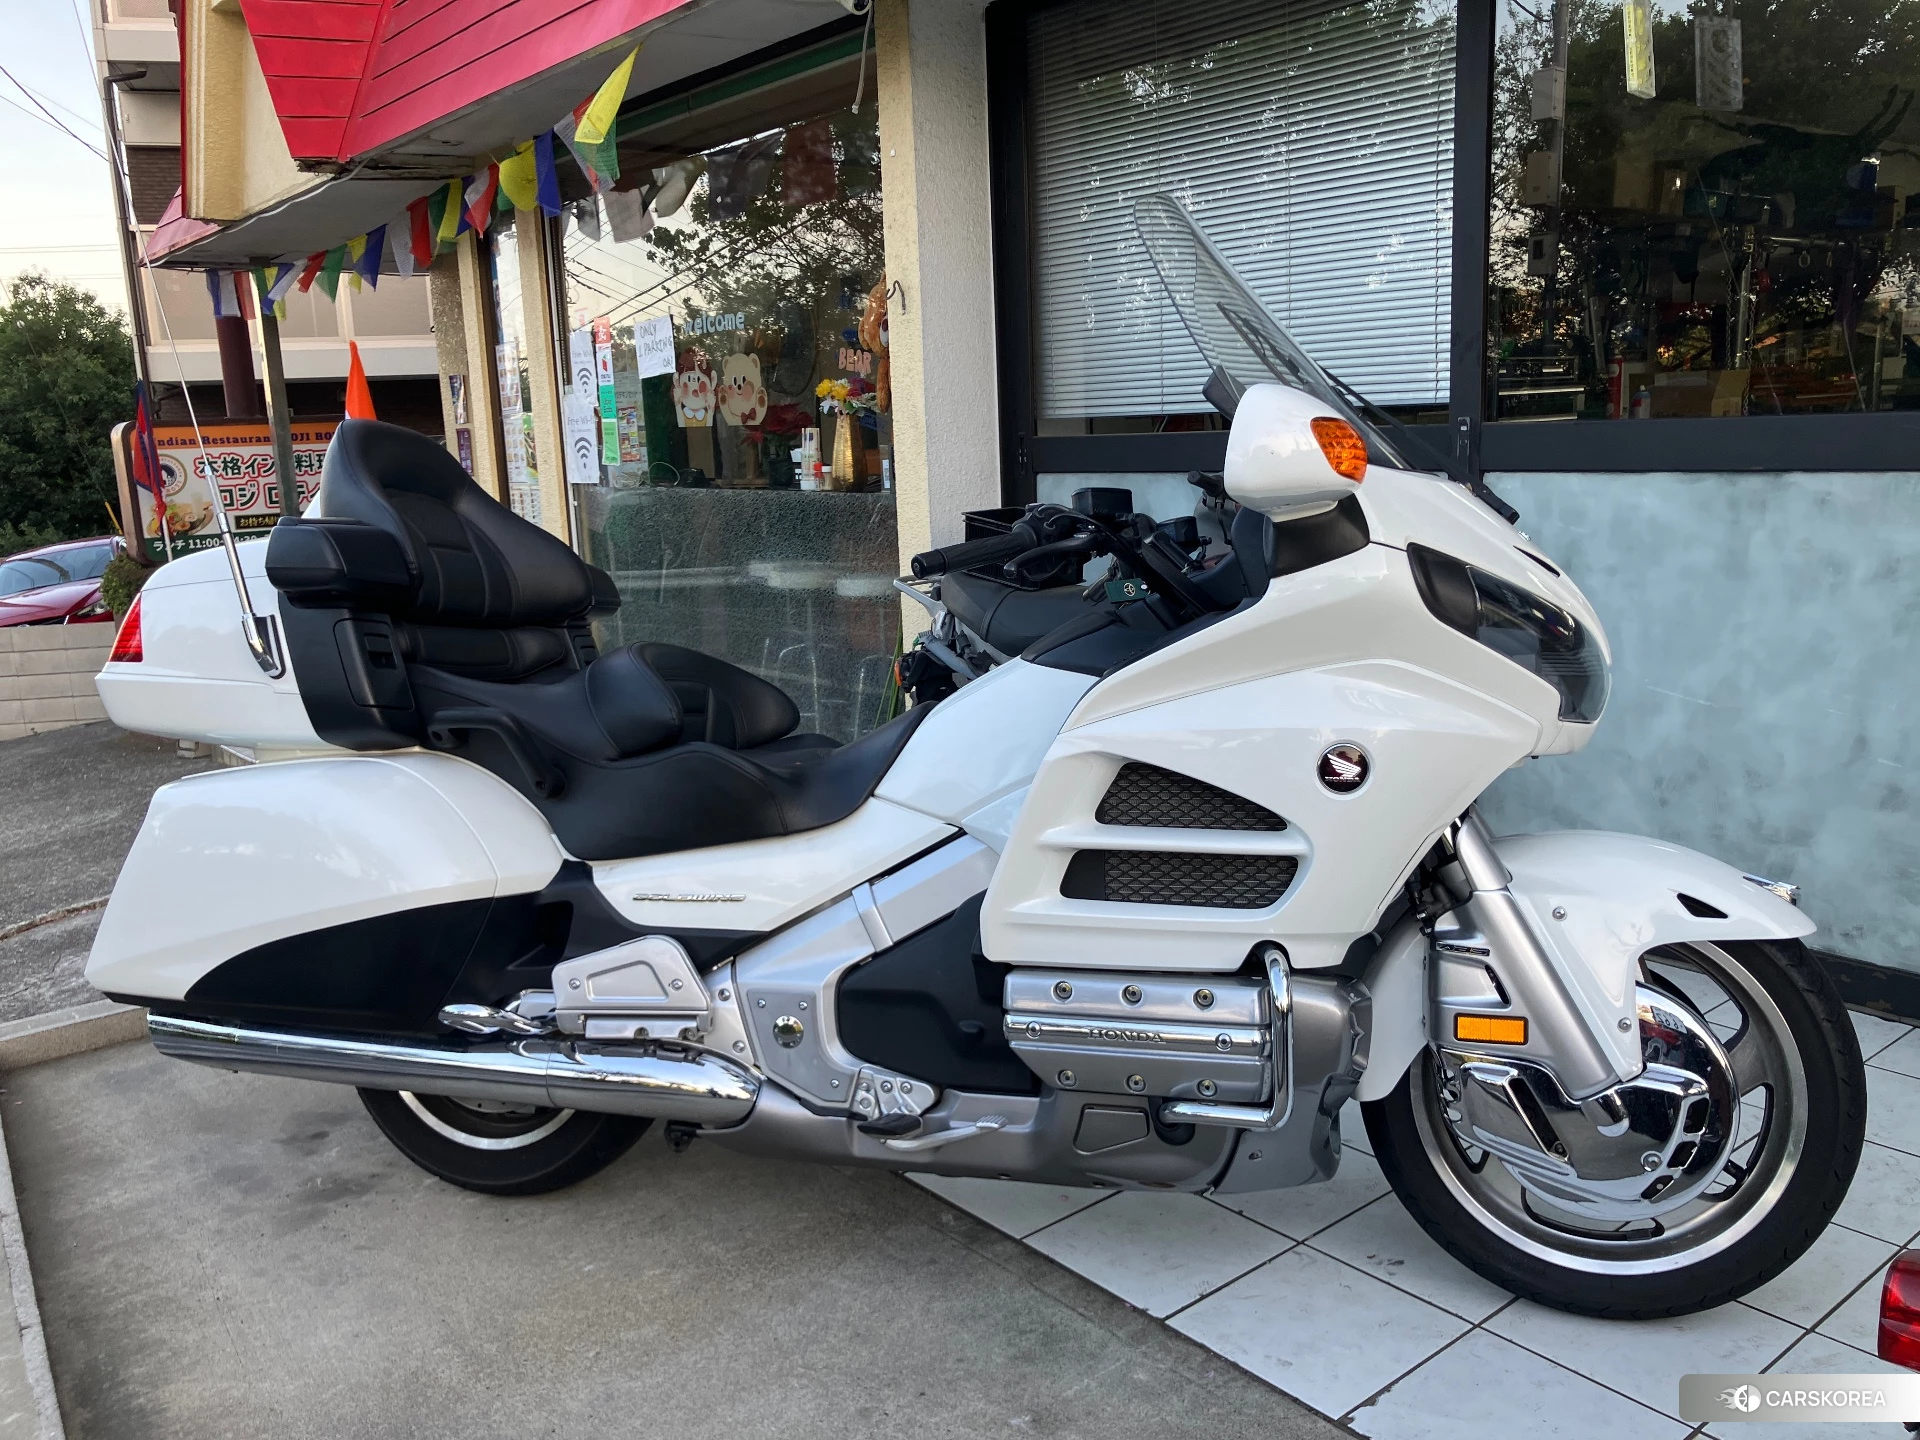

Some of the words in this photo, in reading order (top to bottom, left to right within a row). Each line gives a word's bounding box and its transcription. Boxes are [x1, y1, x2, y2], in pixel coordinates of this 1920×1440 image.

[684, 311, 745, 335] welcome
[839, 347, 871, 375] BEAR
[567, 417, 579, 425] Free
[157, 437, 196, 446] ndian
[1087, 1028, 1167, 1044] HONDA
